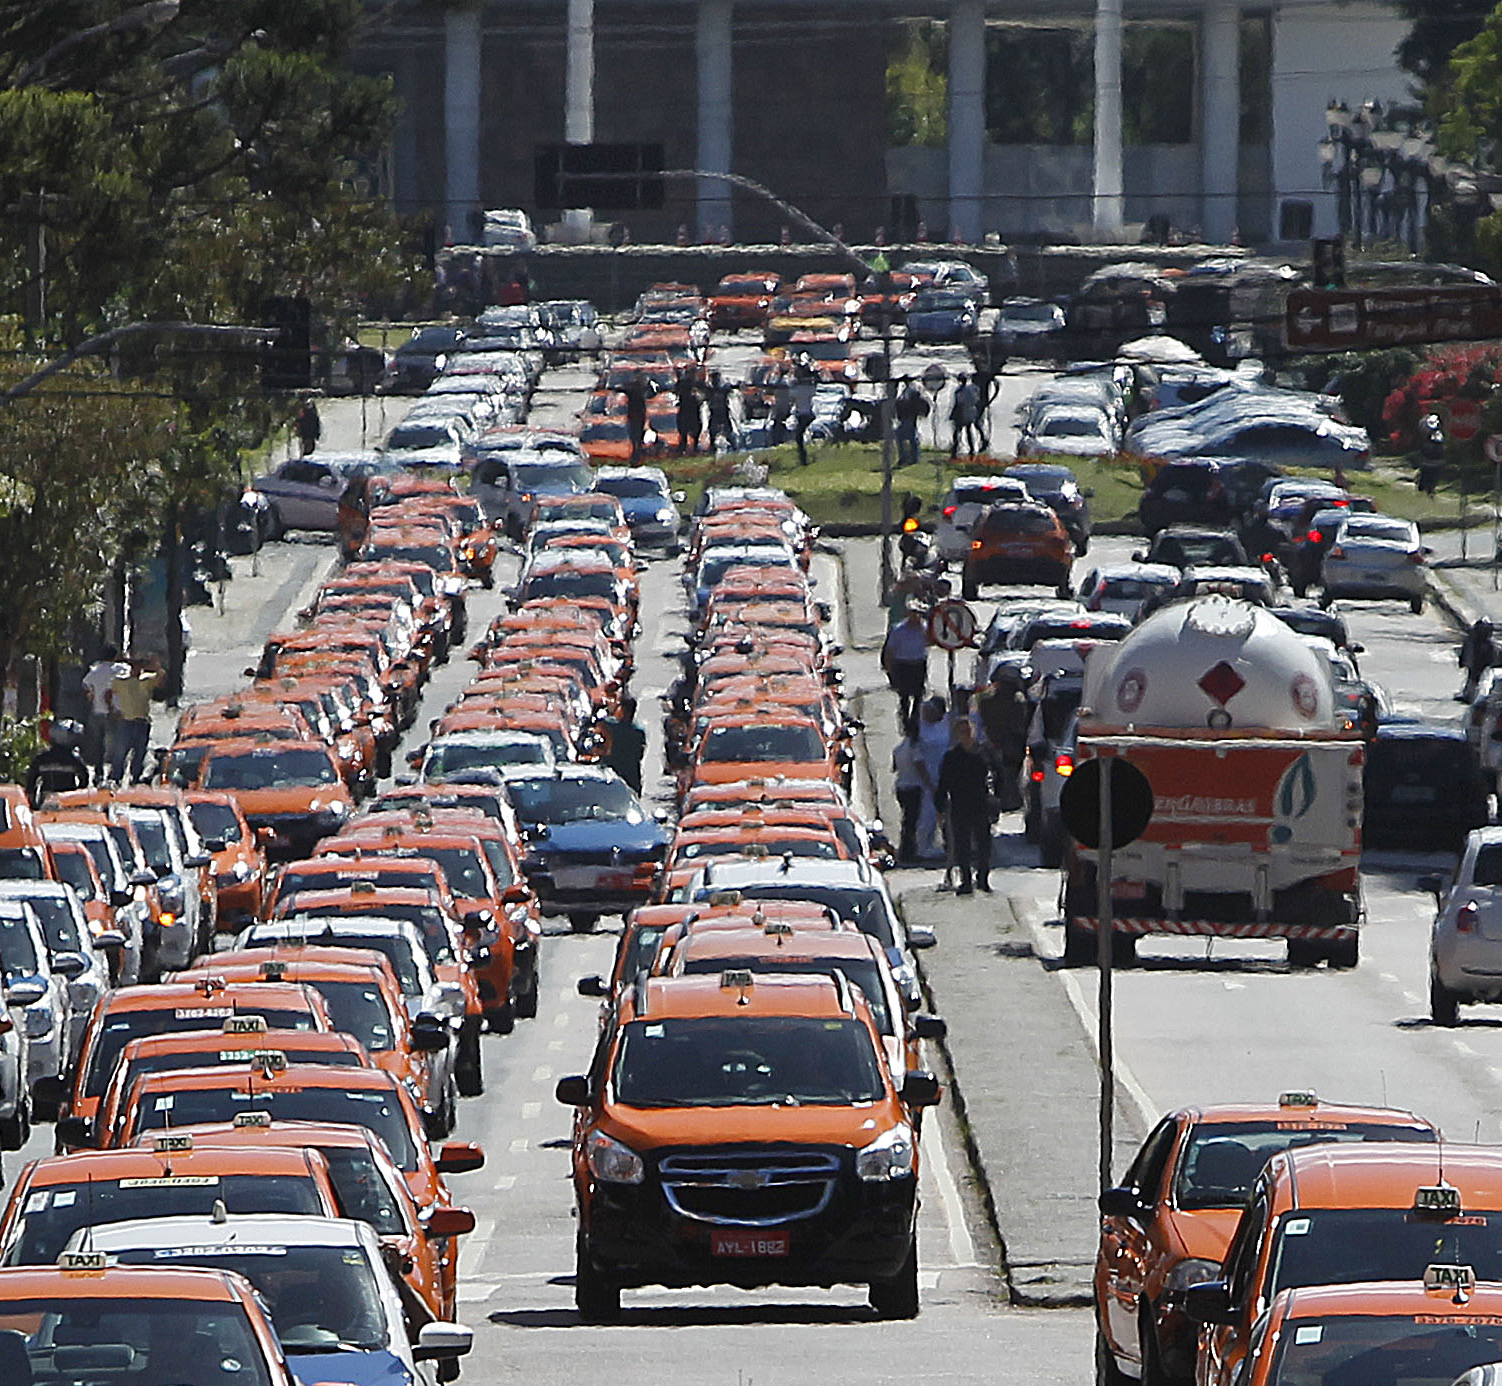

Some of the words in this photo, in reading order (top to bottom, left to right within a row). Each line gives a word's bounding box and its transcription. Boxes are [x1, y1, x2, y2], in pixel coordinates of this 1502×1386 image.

[233, 1021, 259, 1031] TAXI
[238, 1115, 265, 1125] TAXI
[158, 1138, 188, 1149] TAXI
[1420, 1189, 1456, 1205] TAXI
[64, 1255, 100, 1266] TAXI
[1431, 1268, 1468, 1284] TAXI
